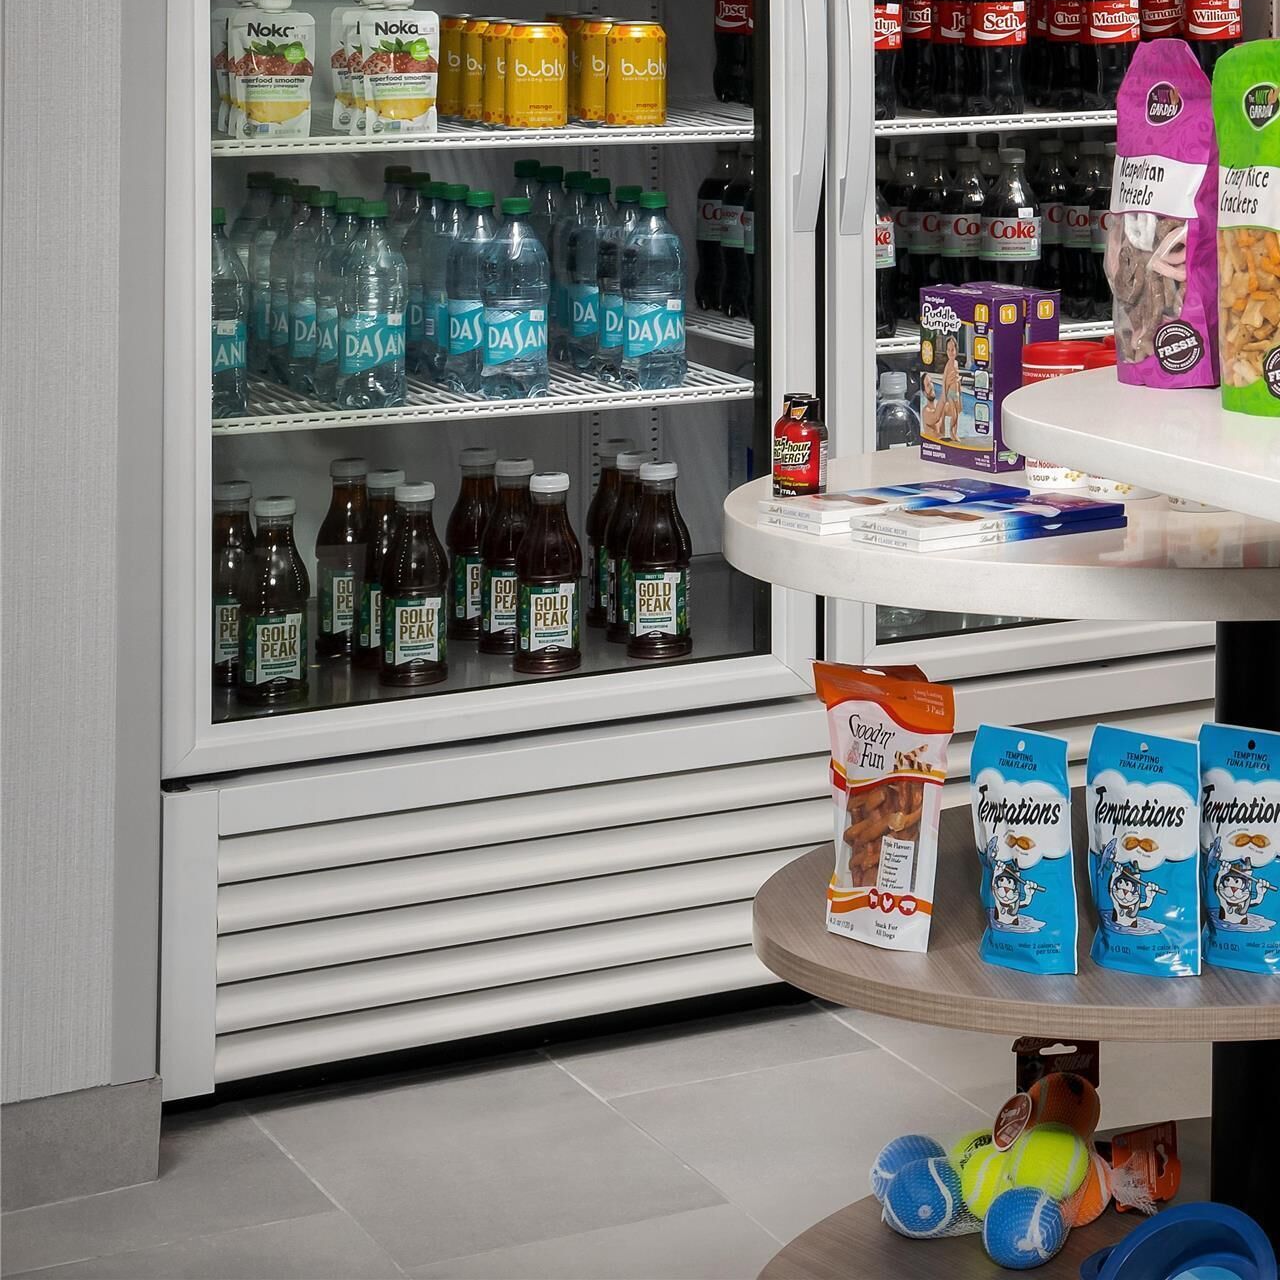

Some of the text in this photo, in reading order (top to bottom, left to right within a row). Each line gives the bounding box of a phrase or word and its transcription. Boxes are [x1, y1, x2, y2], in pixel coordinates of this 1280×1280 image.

[984, 12, 1019, 31] Seth
[1194, 9, 1237, 23] William
[374, 20, 420, 36] Noka
[404, 74, 432, 82] smoothie
[515, 58, 566, 81] bubly
[1120, 156, 1165, 183] Neapolitan
[1247, 166, 1270, 188] Rice
[1119, 184, 1153, 206] Pretzels
[1220, 192, 1258, 214] Crackers
[990, 218, 1036, 239] Coke
[923, 305, 956, 320] Puddle
[923, 316, 960, 333] Jumper
[1157, 335, 1199, 357] FRESH
[638, 581, 672, 598] GOLD
[638, 596, 673, 614] PEAK
[859, 743, 885, 770] Fun
[1119, 760, 1136, 769] TUNA
[1126, 752, 1160, 764] TEMPTING
[1095, 786, 1186, 834] Temptations
